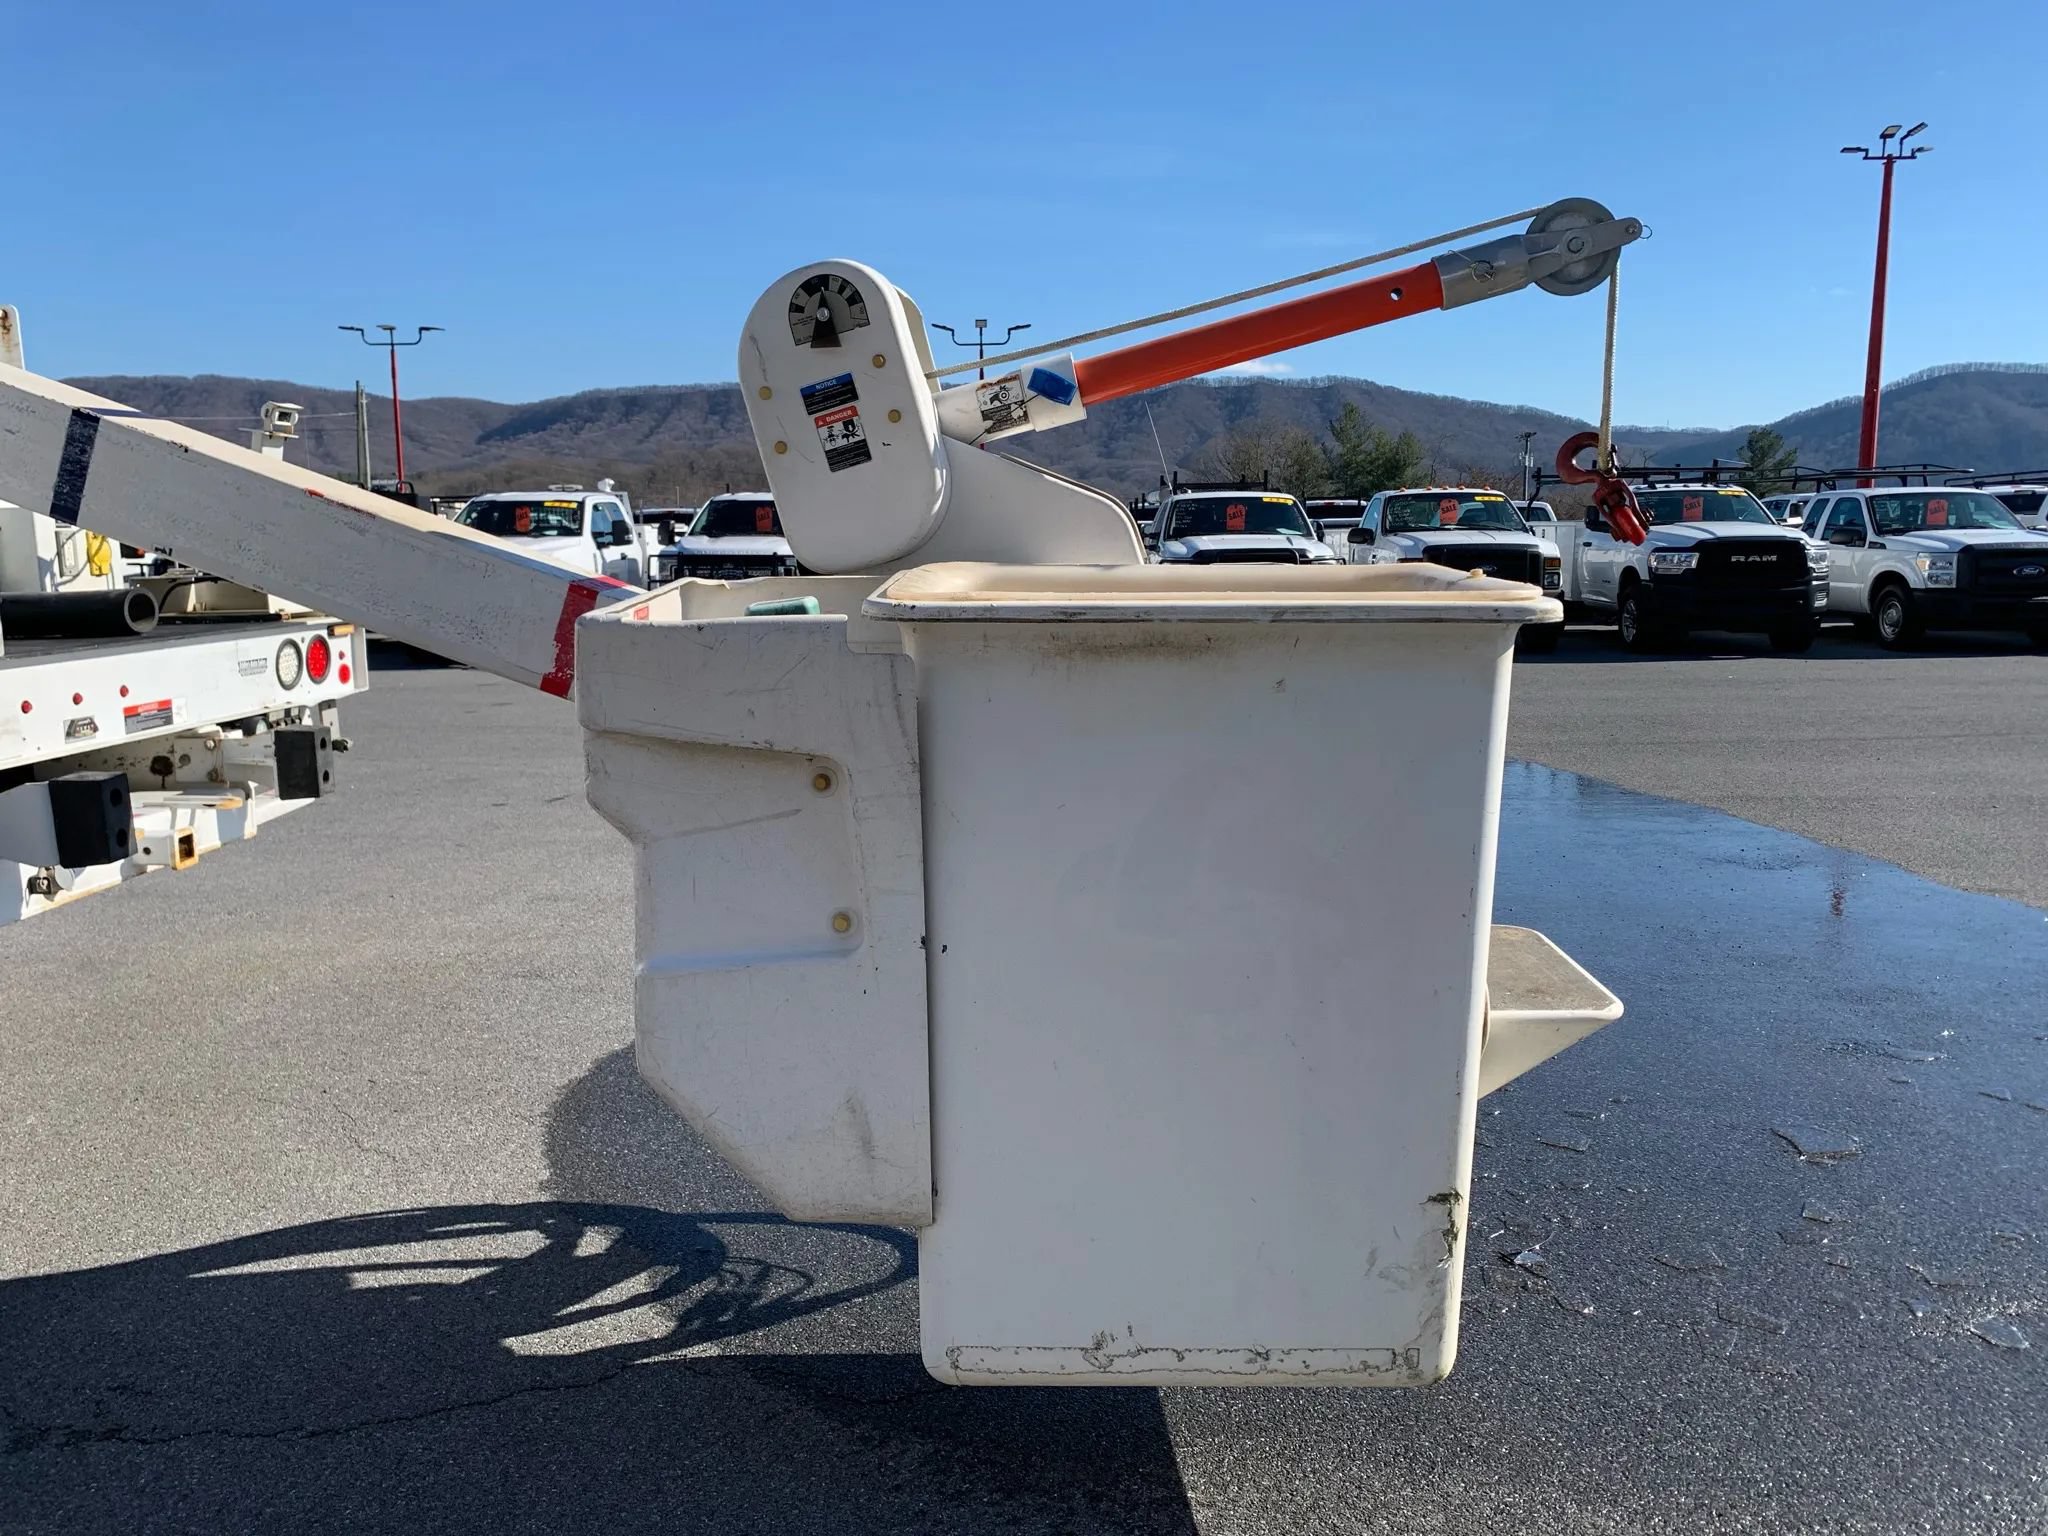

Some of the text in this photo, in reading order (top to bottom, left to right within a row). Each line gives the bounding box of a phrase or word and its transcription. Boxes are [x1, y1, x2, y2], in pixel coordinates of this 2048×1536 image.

[815, 379, 838, 389] NOTICE
[825, 410, 852, 422] DANGER
[1228, 509, 1244, 521] SALE
[1441, 504, 1457, 515] SALE
[1731, 554, 1778, 562] RAM
